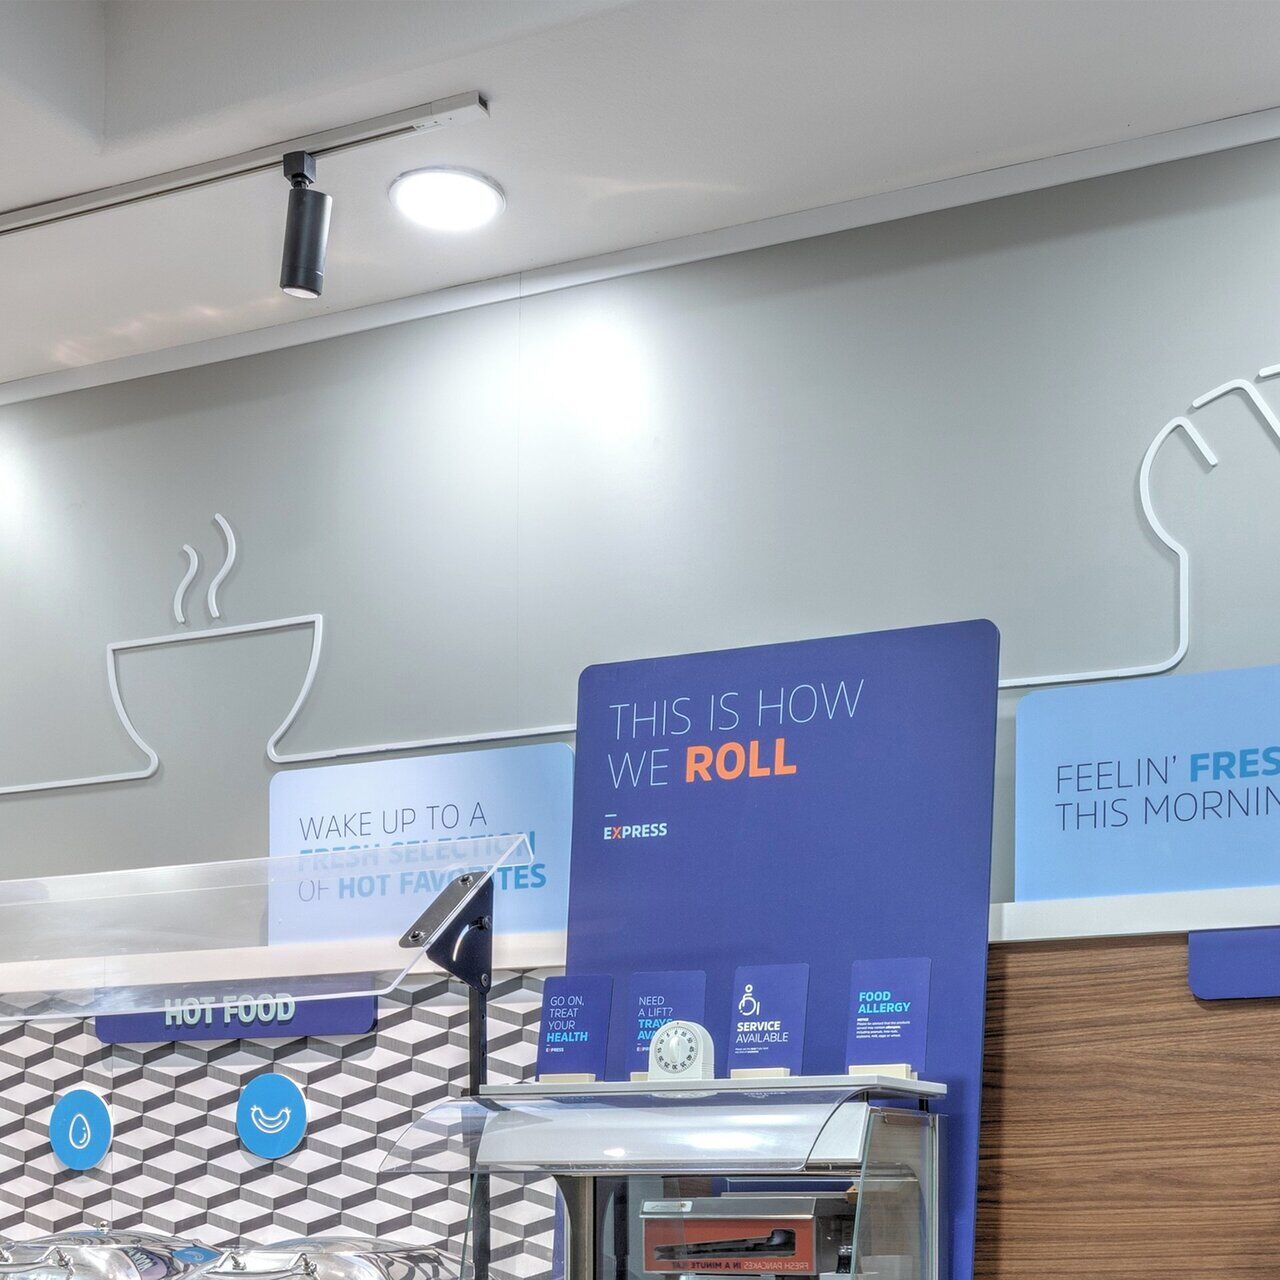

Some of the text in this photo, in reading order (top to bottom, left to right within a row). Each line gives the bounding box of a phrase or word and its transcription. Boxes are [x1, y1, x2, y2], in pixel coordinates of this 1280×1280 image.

[609, 679, 864, 740] THIS IS HOW
[608, 738, 796, 789] WE ROLL
[1055, 798, 1128, 831] THIS
[299, 802, 487, 841] WAKE UP TO A
[604, 823, 668, 840] EXPRESS
[299, 831, 535, 872] FRESH SELECTION
[298, 879, 329, 902] OF
[339, 874, 390, 900] HOT
[550, 996, 565, 1006] GO
[639, 996, 665, 1006] NEED
[859, 991, 891, 1002] FOOD
[164, 993, 296, 1026] HOT FOOD
[550, 1008, 578, 1018] TREAT
[638, 1006, 673, 1017] A LIFT?
[858, 1002, 911, 1014] ALLERGY
[548, 1020, 575, 1030] YOUR
[737, 1021, 781, 1032] SERVICE
[547, 1032, 588, 1043] HEALTH
[736, 1032, 789, 1044] AVAILABLE
